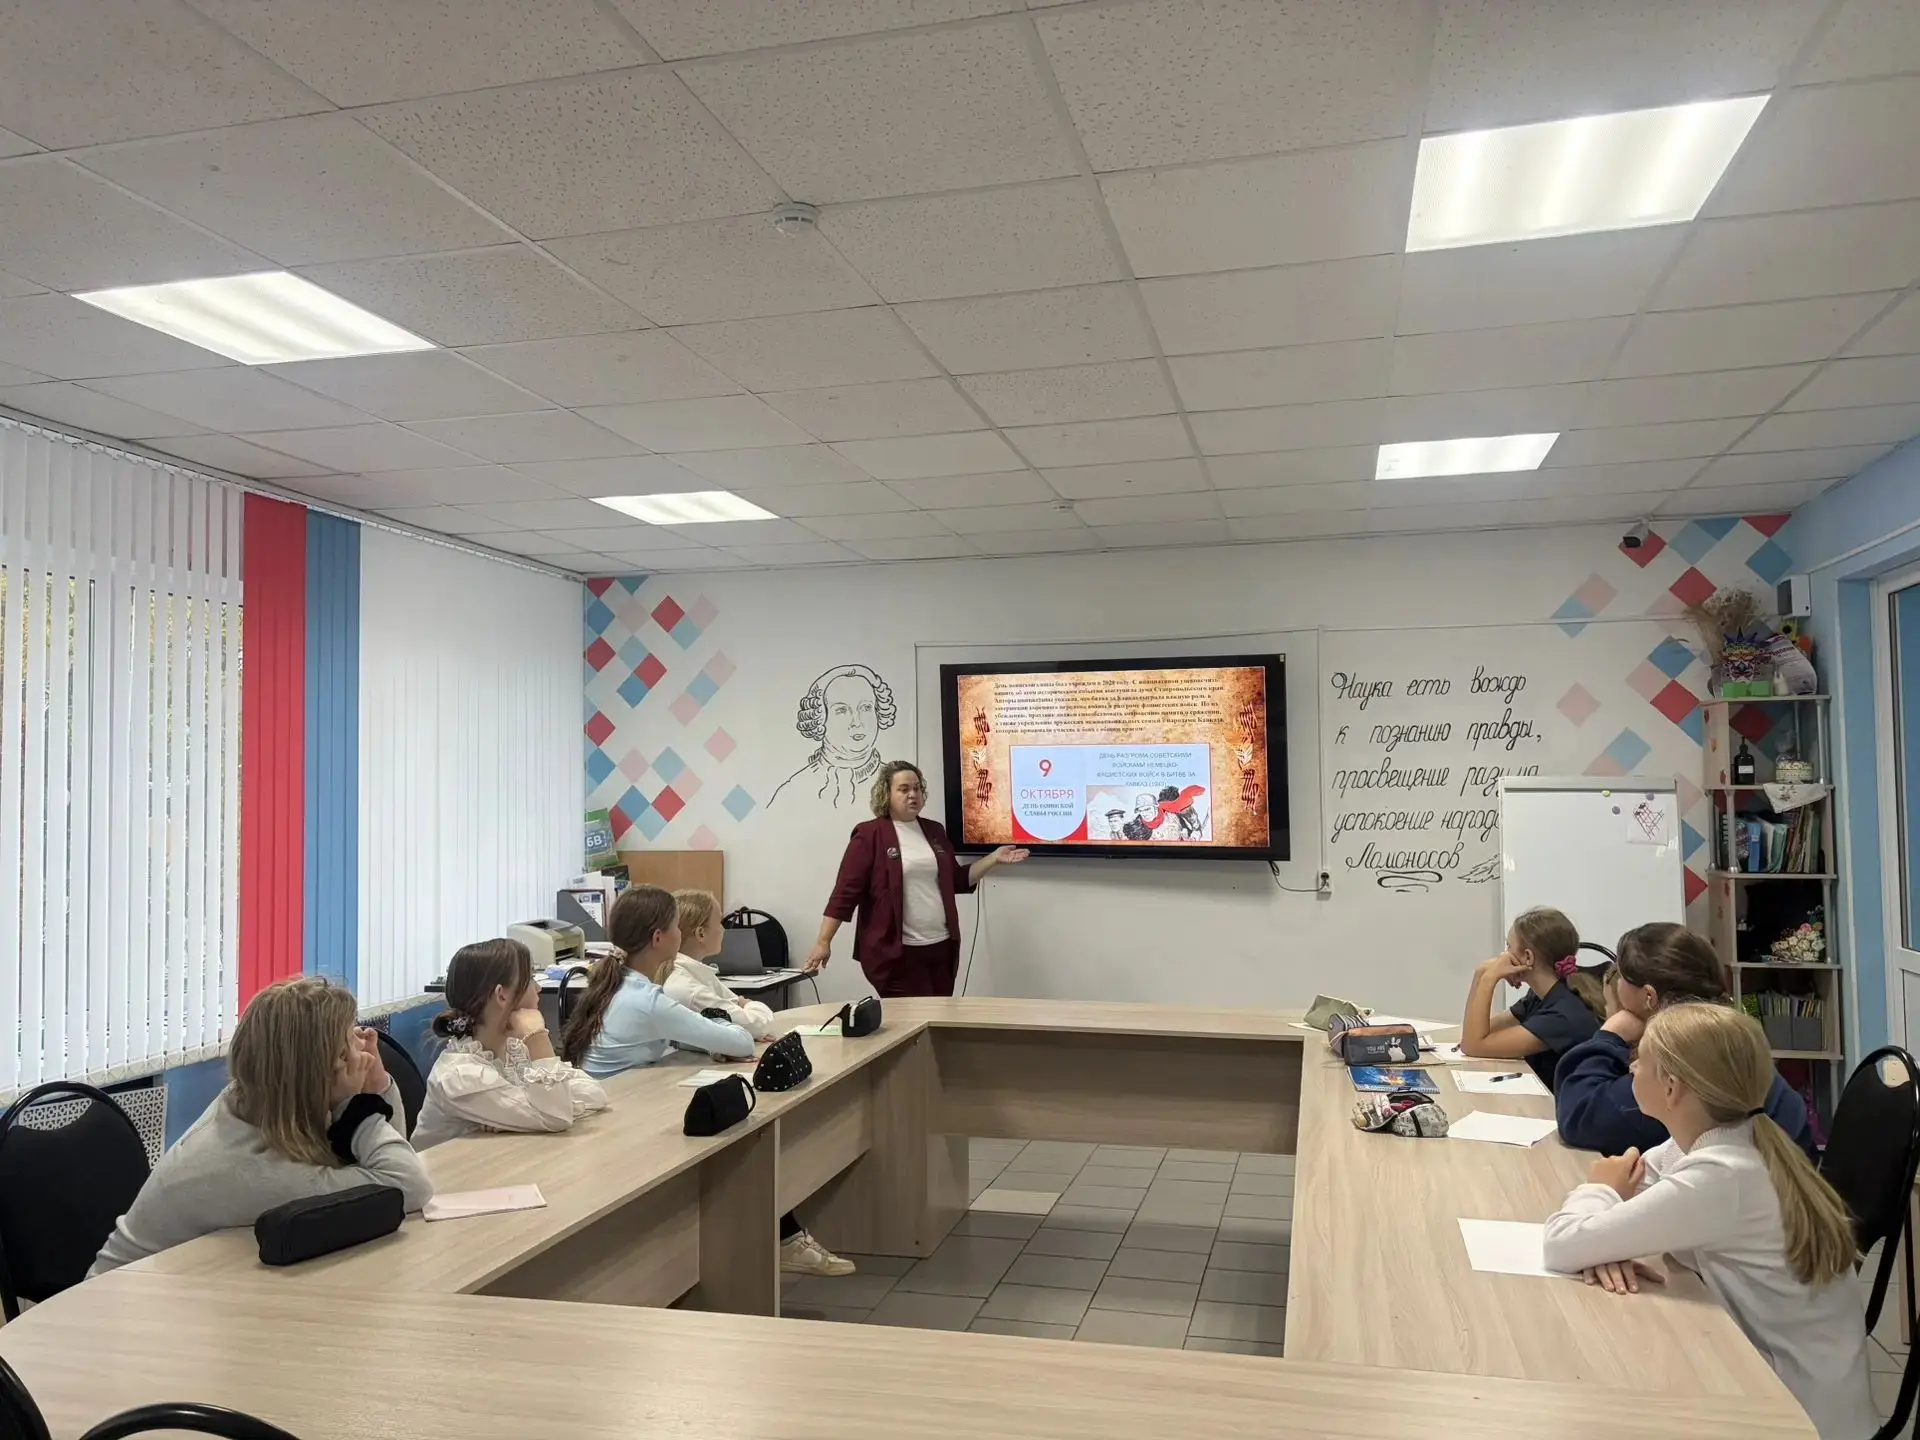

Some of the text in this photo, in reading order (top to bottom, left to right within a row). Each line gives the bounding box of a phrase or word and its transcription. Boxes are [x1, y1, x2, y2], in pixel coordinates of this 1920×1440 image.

[1330, 671, 1393, 711] Наука
[1407, 678, 1451, 697] есть
[1369, 721, 1451, 752] познанию
[1466, 707, 1542, 751] правды,
[1039, 759, 1052, 777] 9
[1331, 757, 1450, 799] просвещение
[1020, 789, 1074, 800] ОКТЯБРЯ
[1330, 808, 1434, 844] успокоение
[1345, 841, 1465, 871] Ломоносов
